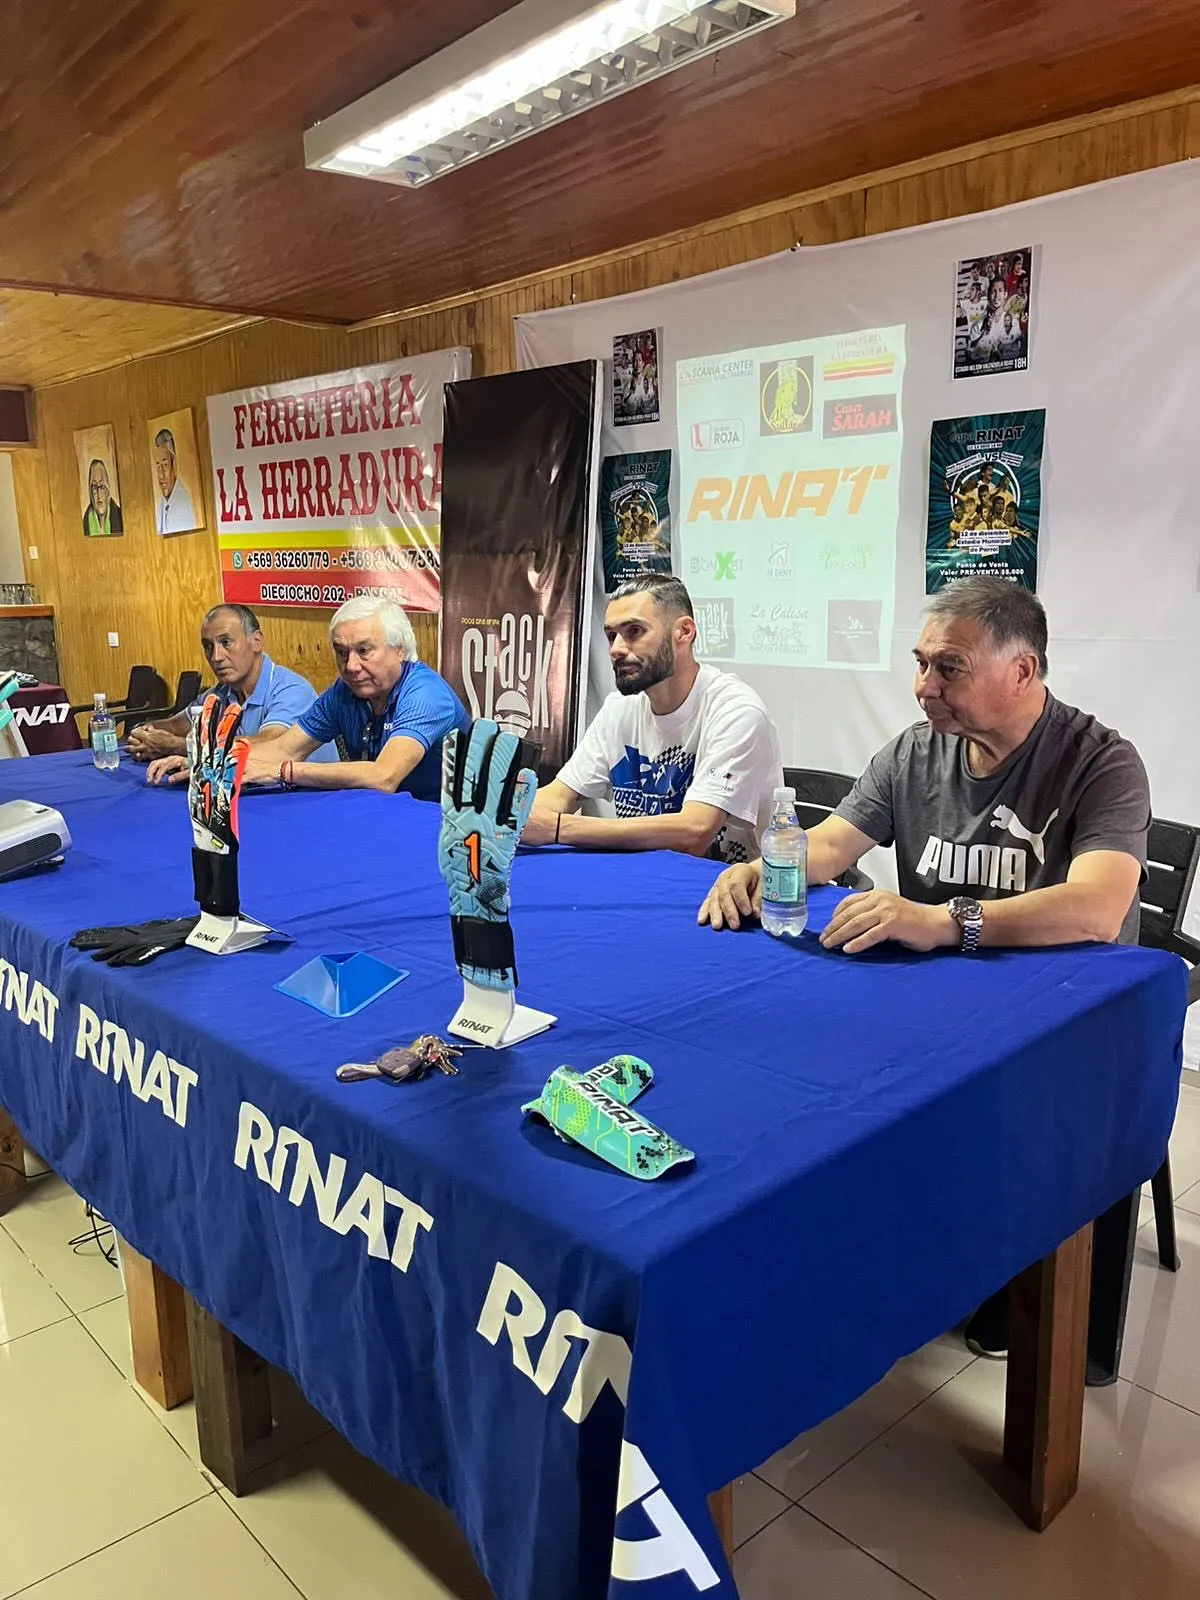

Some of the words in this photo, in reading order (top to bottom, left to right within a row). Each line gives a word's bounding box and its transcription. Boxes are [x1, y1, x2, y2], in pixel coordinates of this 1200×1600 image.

[692, 365, 720, 378] SCANIA
[722, 359, 754, 373] CENTER
[1014, 357, 1027, 369] 18H
[233, 373, 422, 450] FERRETERIA
[831, 409, 892, 431] SARAH
[713, 431, 740, 445] ROJA
[975, 425, 1026, 443] RINAT
[983, 452, 1000, 462] VS
[629, 461, 660, 475] RINAT
[216, 465, 253, 523] LA
[258, 442, 443, 521] HERRADURA
[686, 464, 891, 523] RINAT
[247, 552, 272, 568] +569
[275, 551, 330, 568] 36260779
[261, 585, 320, 601] DIECIOCHO
[324, 586, 345, 602] 202
[915, 834, 1027, 892] PUMA
[194, 932, 220, 943] RINAT
[457, 1018, 495, 1034] RINAT
[75, 1003, 199, 1129] RINAT
[574, 1080, 658, 1135] RINAT
[233, 1101, 435, 1274] RINAT
